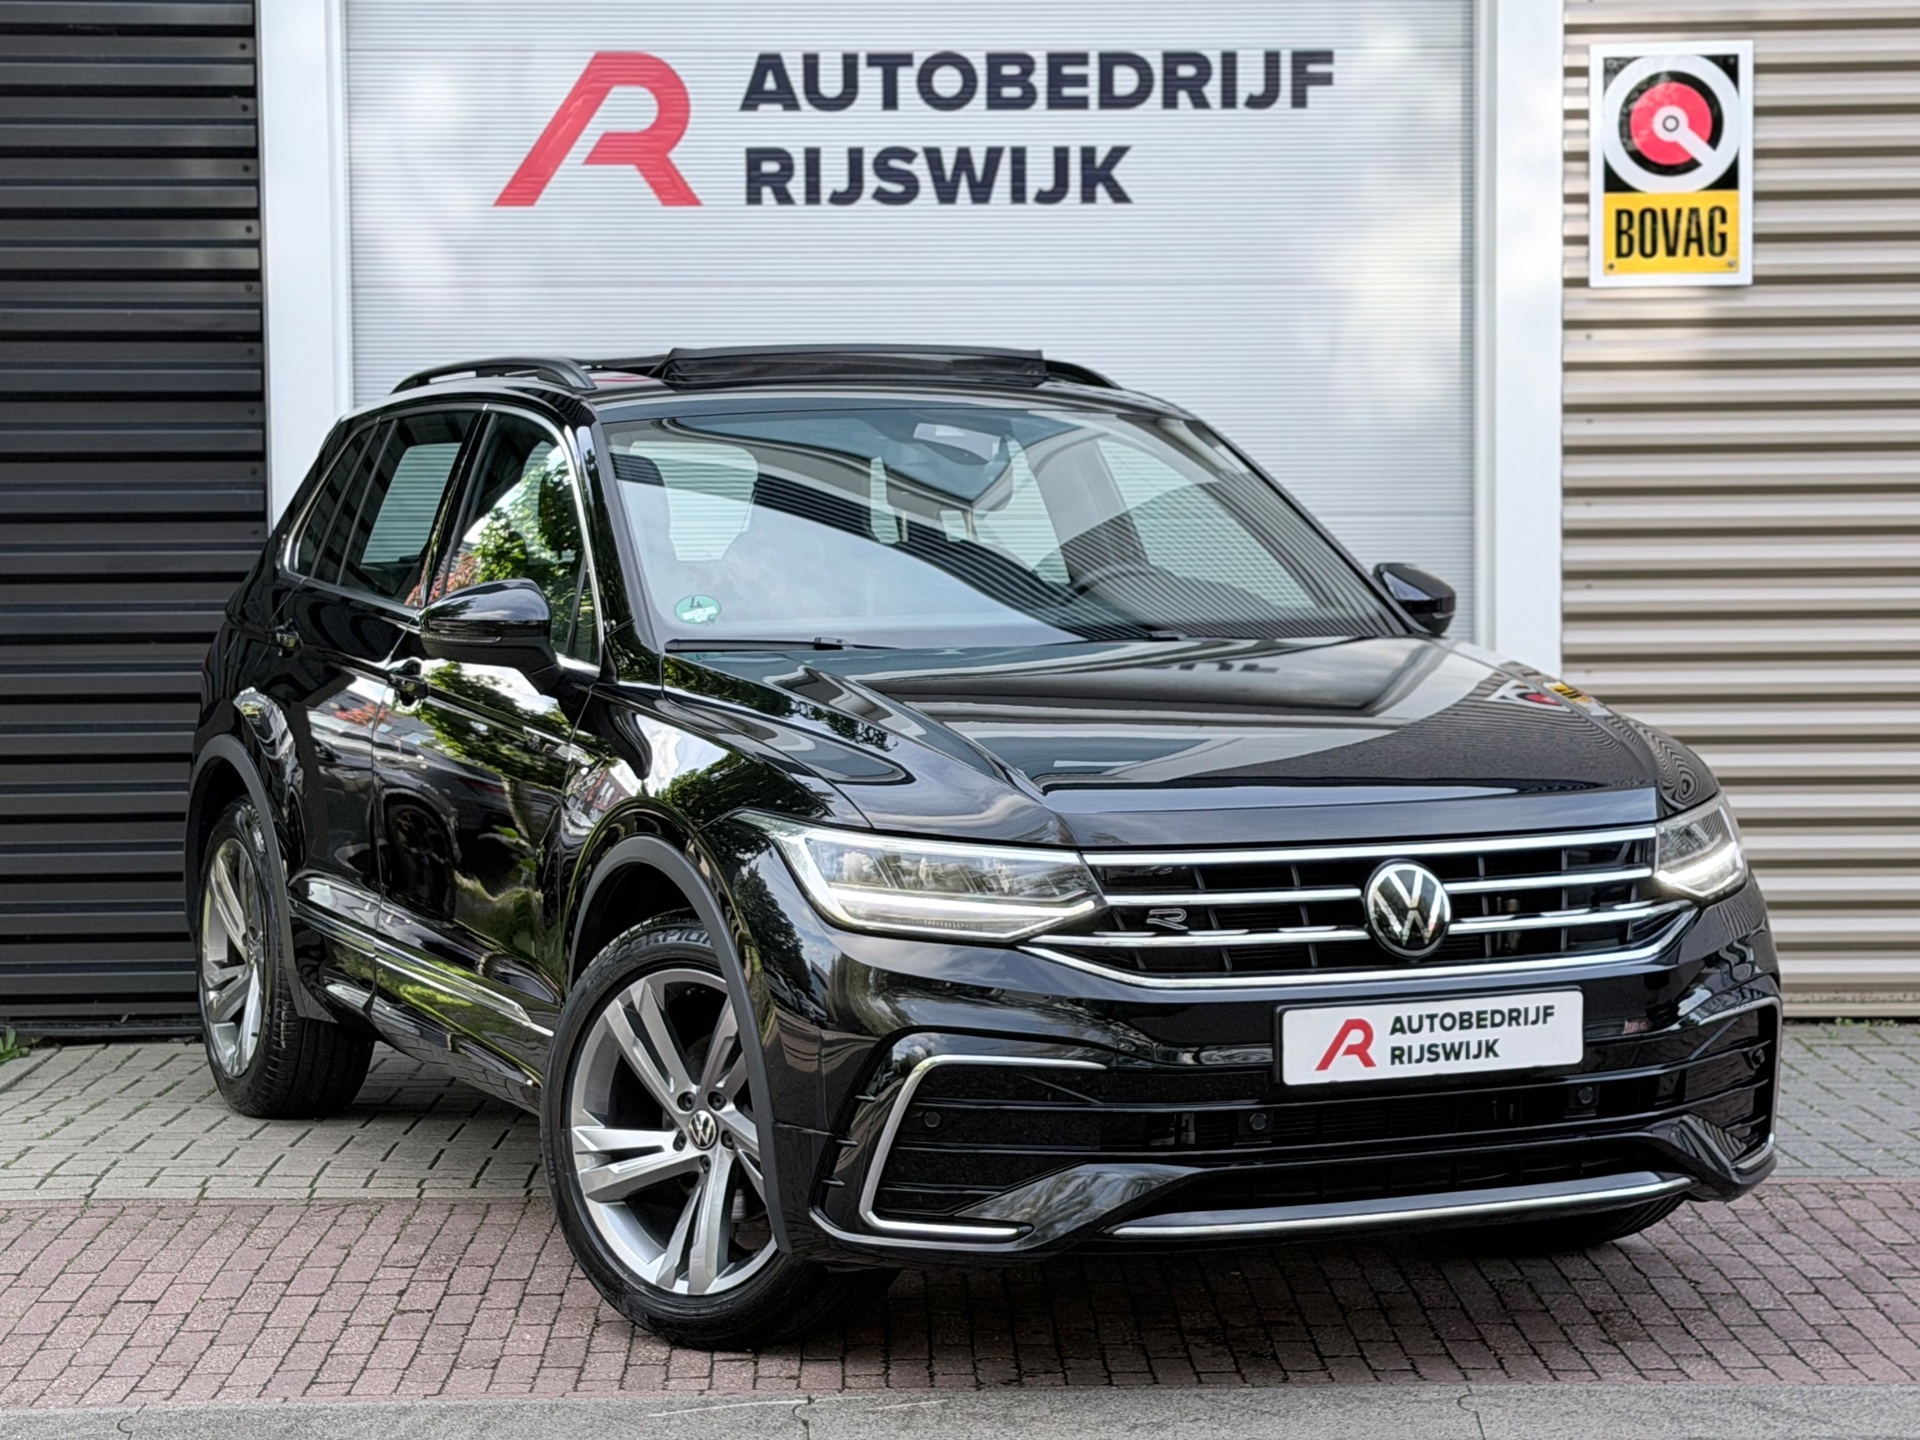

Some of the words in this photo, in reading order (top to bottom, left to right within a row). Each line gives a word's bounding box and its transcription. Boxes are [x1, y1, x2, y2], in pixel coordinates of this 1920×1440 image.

[740, 50, 1334, 112] AUTOBEDRIJF
[745, 146, 1132, 206] RIJSWIJK
[1615, 206, 1728, 259] BOVAG
[1146, 908, 1189, 930] R
[1389, 1005, 1555, 1036] AUTOBEDRIJF
[1390, 1038, 1500, 1066] RIJSWIJK
